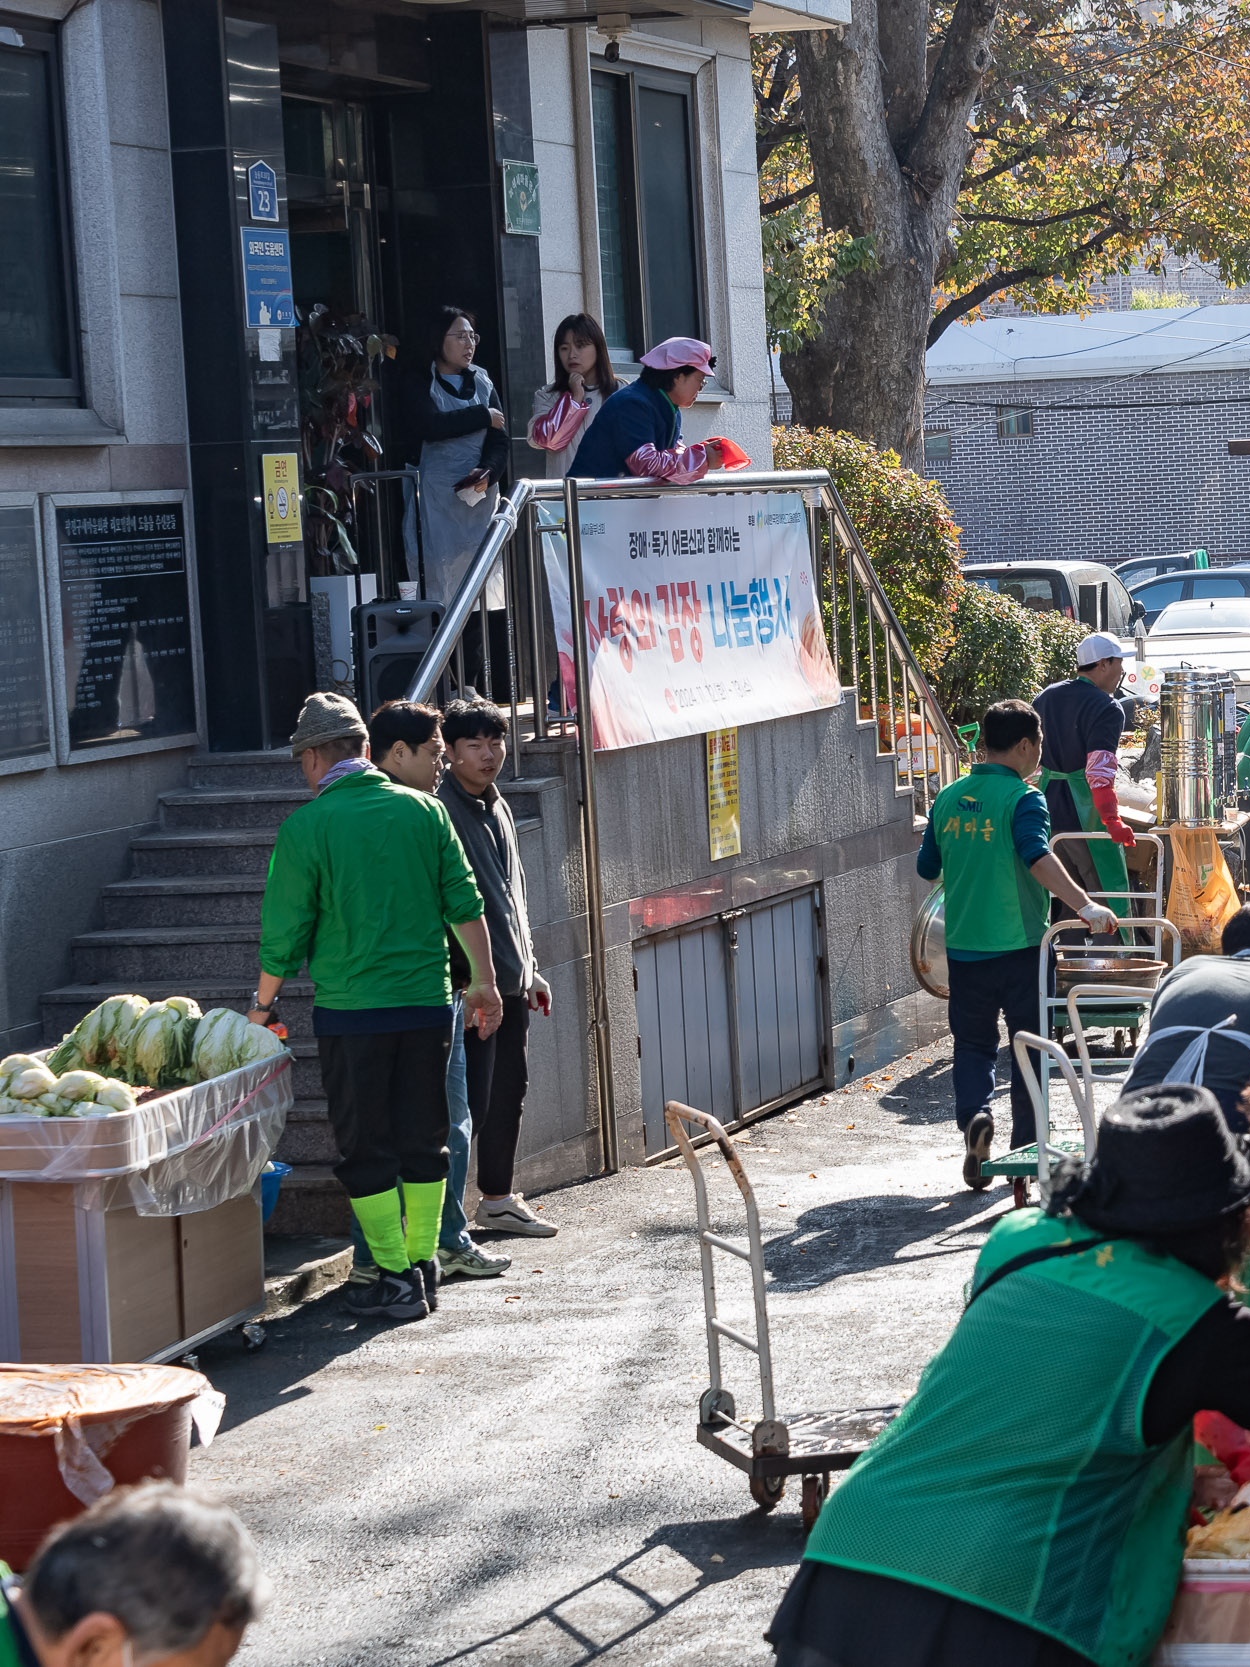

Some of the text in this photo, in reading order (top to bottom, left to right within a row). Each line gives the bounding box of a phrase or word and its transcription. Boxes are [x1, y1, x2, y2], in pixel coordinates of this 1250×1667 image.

[258, 190, 270, 212] 23
[248, 241, 264, 255] 외국인
[275, 460, 287, 478] 금연
[629, 526, 741, 559] 장애·독거 어르신과 함께하는
[584, 587, 657, 674] 사랑의
[656, 580, 703, 663] 김장
[957, 799, 984, 813] SMU
[943, 815, 995, 842] 새마을
